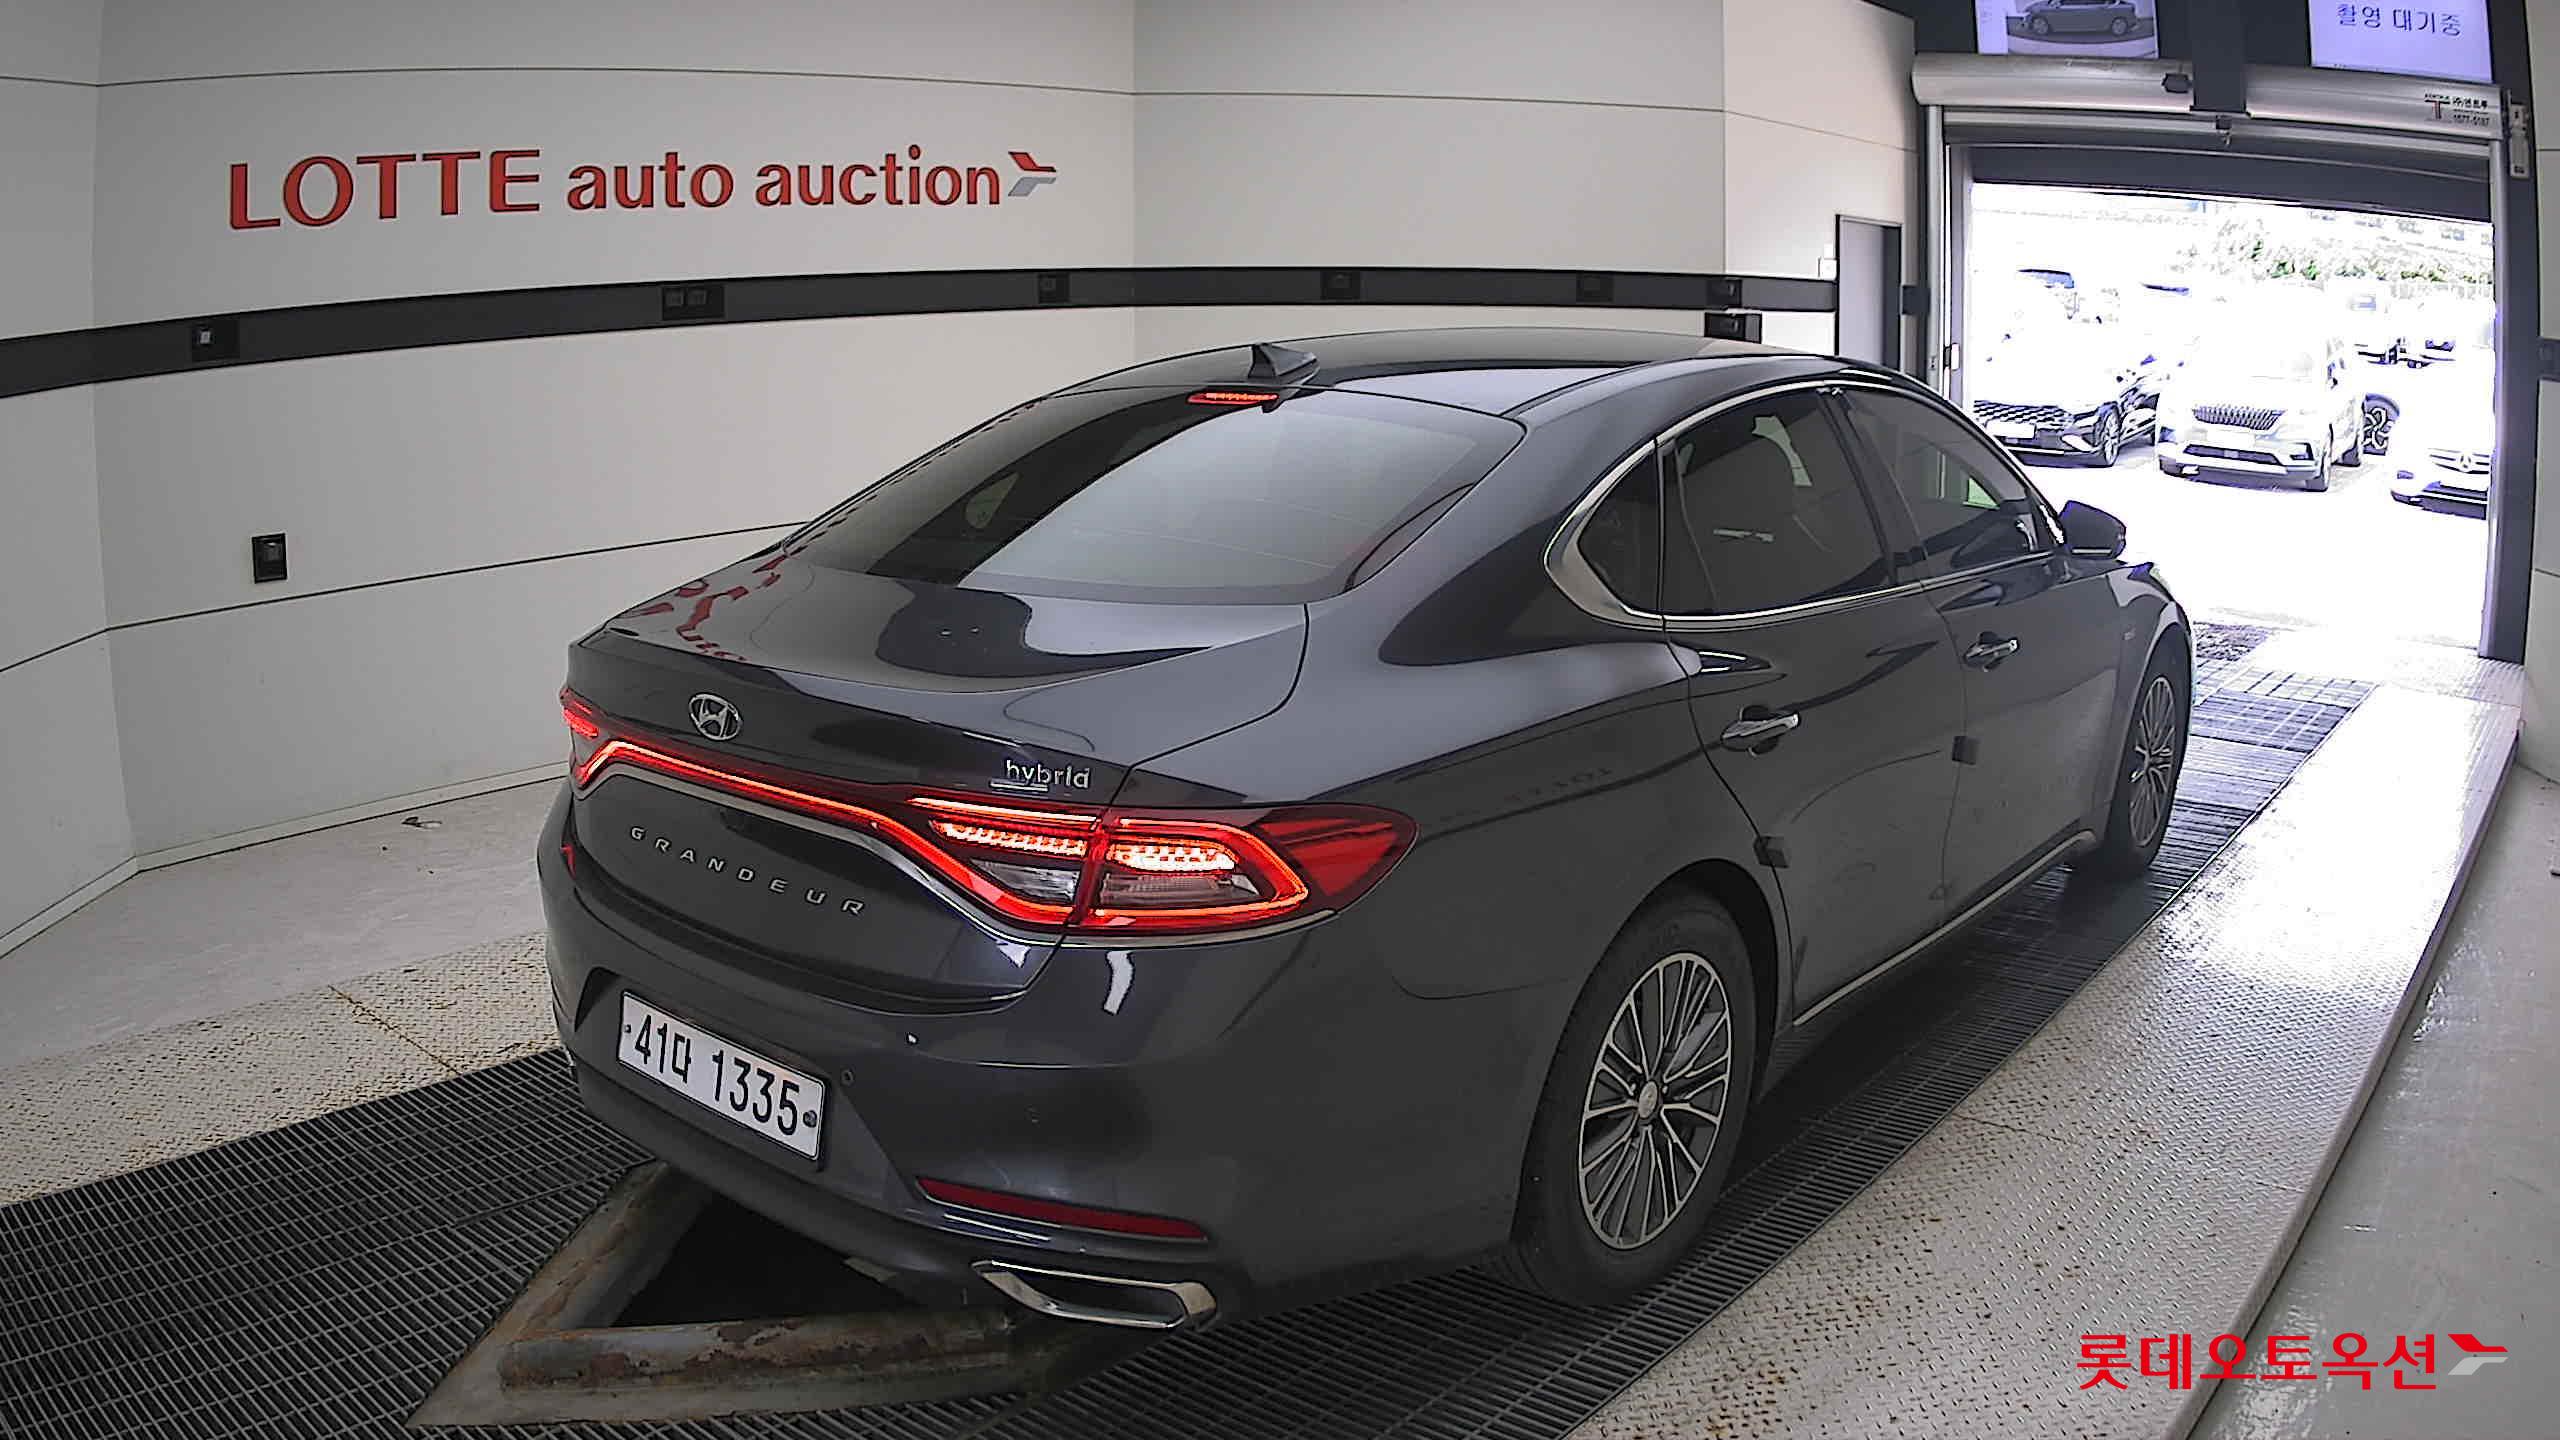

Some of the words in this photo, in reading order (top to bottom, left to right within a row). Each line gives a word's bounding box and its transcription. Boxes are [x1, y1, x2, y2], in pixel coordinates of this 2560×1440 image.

[2338, 4, 2381, 28] 촬영
[2393, 8, 2461, 36] 대기중
[229, 149, 541, 230] LOTTE
[566, 151, 735, 210] auto
[755, 145, 1002, 206] auction
[1006, 759, 1090, 789] hybrid
[630, 826, 864, 915] GRANDEUR
[712, 1049, 800, 1136] 1335
